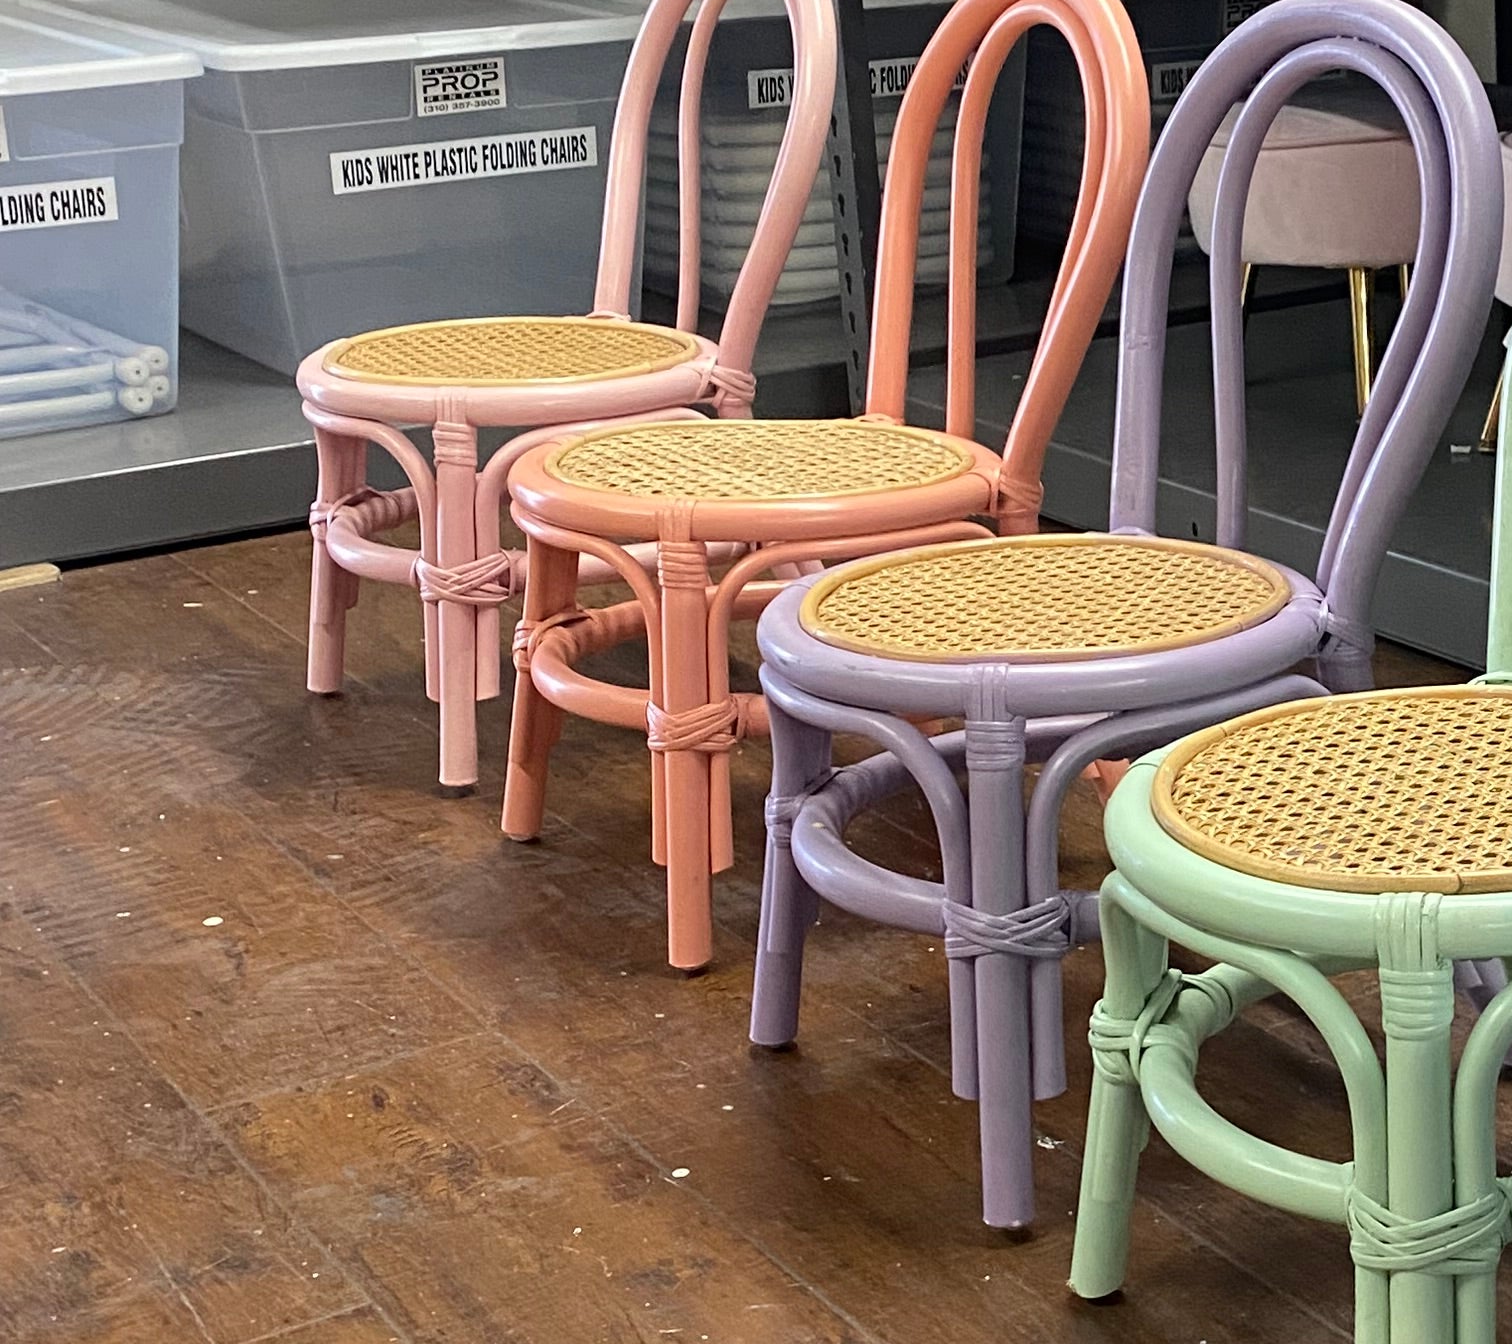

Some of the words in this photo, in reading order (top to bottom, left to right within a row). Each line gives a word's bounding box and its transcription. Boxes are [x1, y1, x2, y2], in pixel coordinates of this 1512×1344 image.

[422, 62, 498, 76] PLATINUM
[880, 63, 916, 93] FOLDI
[1160, 68, 1184, 94] KIDS
[422, 71, 499, 94] PROP
[757, 75, 785, 104] KIDS
[423, 103, 448, 114] (310)
[452, 99, 501, 111] 357-3900
[424, 89, 500, 103] RENTALS
[341, 158, 373, 189] KIDS
[376, 152, 420, 184] WHITE
[424, 145, 478, 178] PLASTIC
[482, 139, 536, 172] FOLDING
[541, 133, 588, 165] CHAIRS
[0, 192, 45, 226] LDING
[50, 186, 106, 222] CHAIRS
